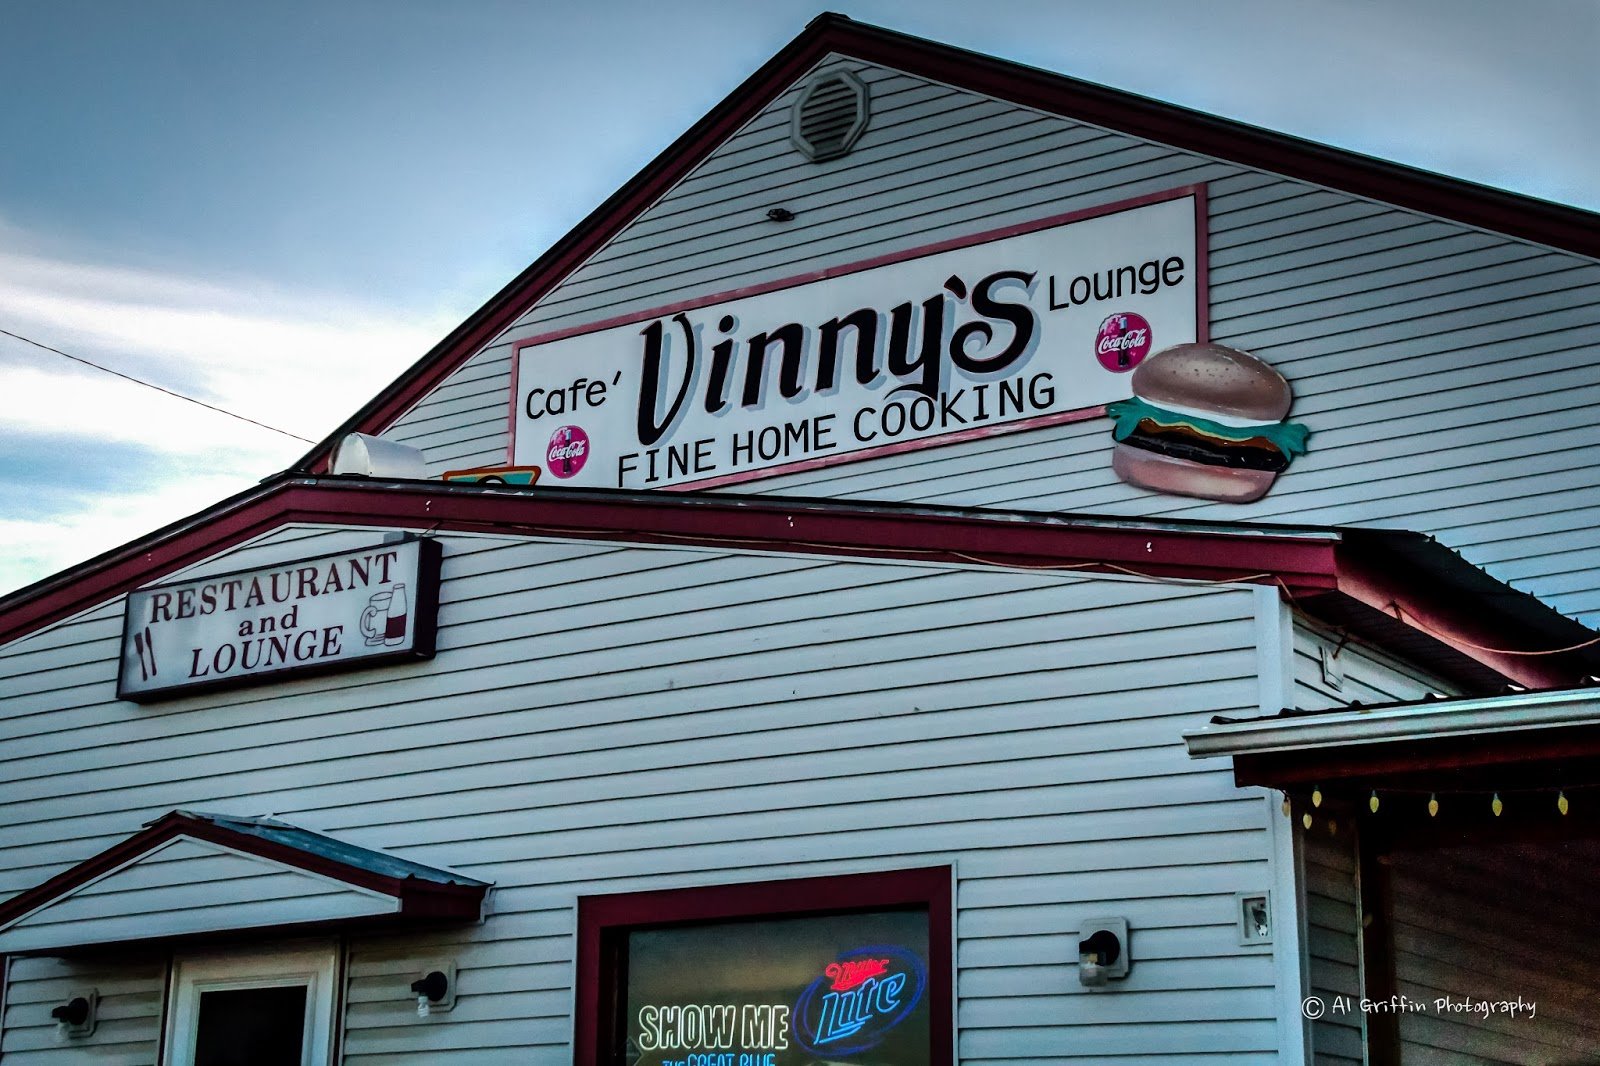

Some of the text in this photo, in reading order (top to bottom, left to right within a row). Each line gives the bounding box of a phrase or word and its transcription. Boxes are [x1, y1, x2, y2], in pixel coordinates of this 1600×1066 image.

[1048, 255, 1185, 311] Lounge
[618, 372, 1056, 488] FINE HOME COOKING
[150, 551, 398, 624] RESTAURANT
[238, 605, 299, 637] and
[188, 625, 345, 679] LOUNGE
[638, 1004, 790, 1050] SHOW ME
[813, 972, 906, 1045] Lite
